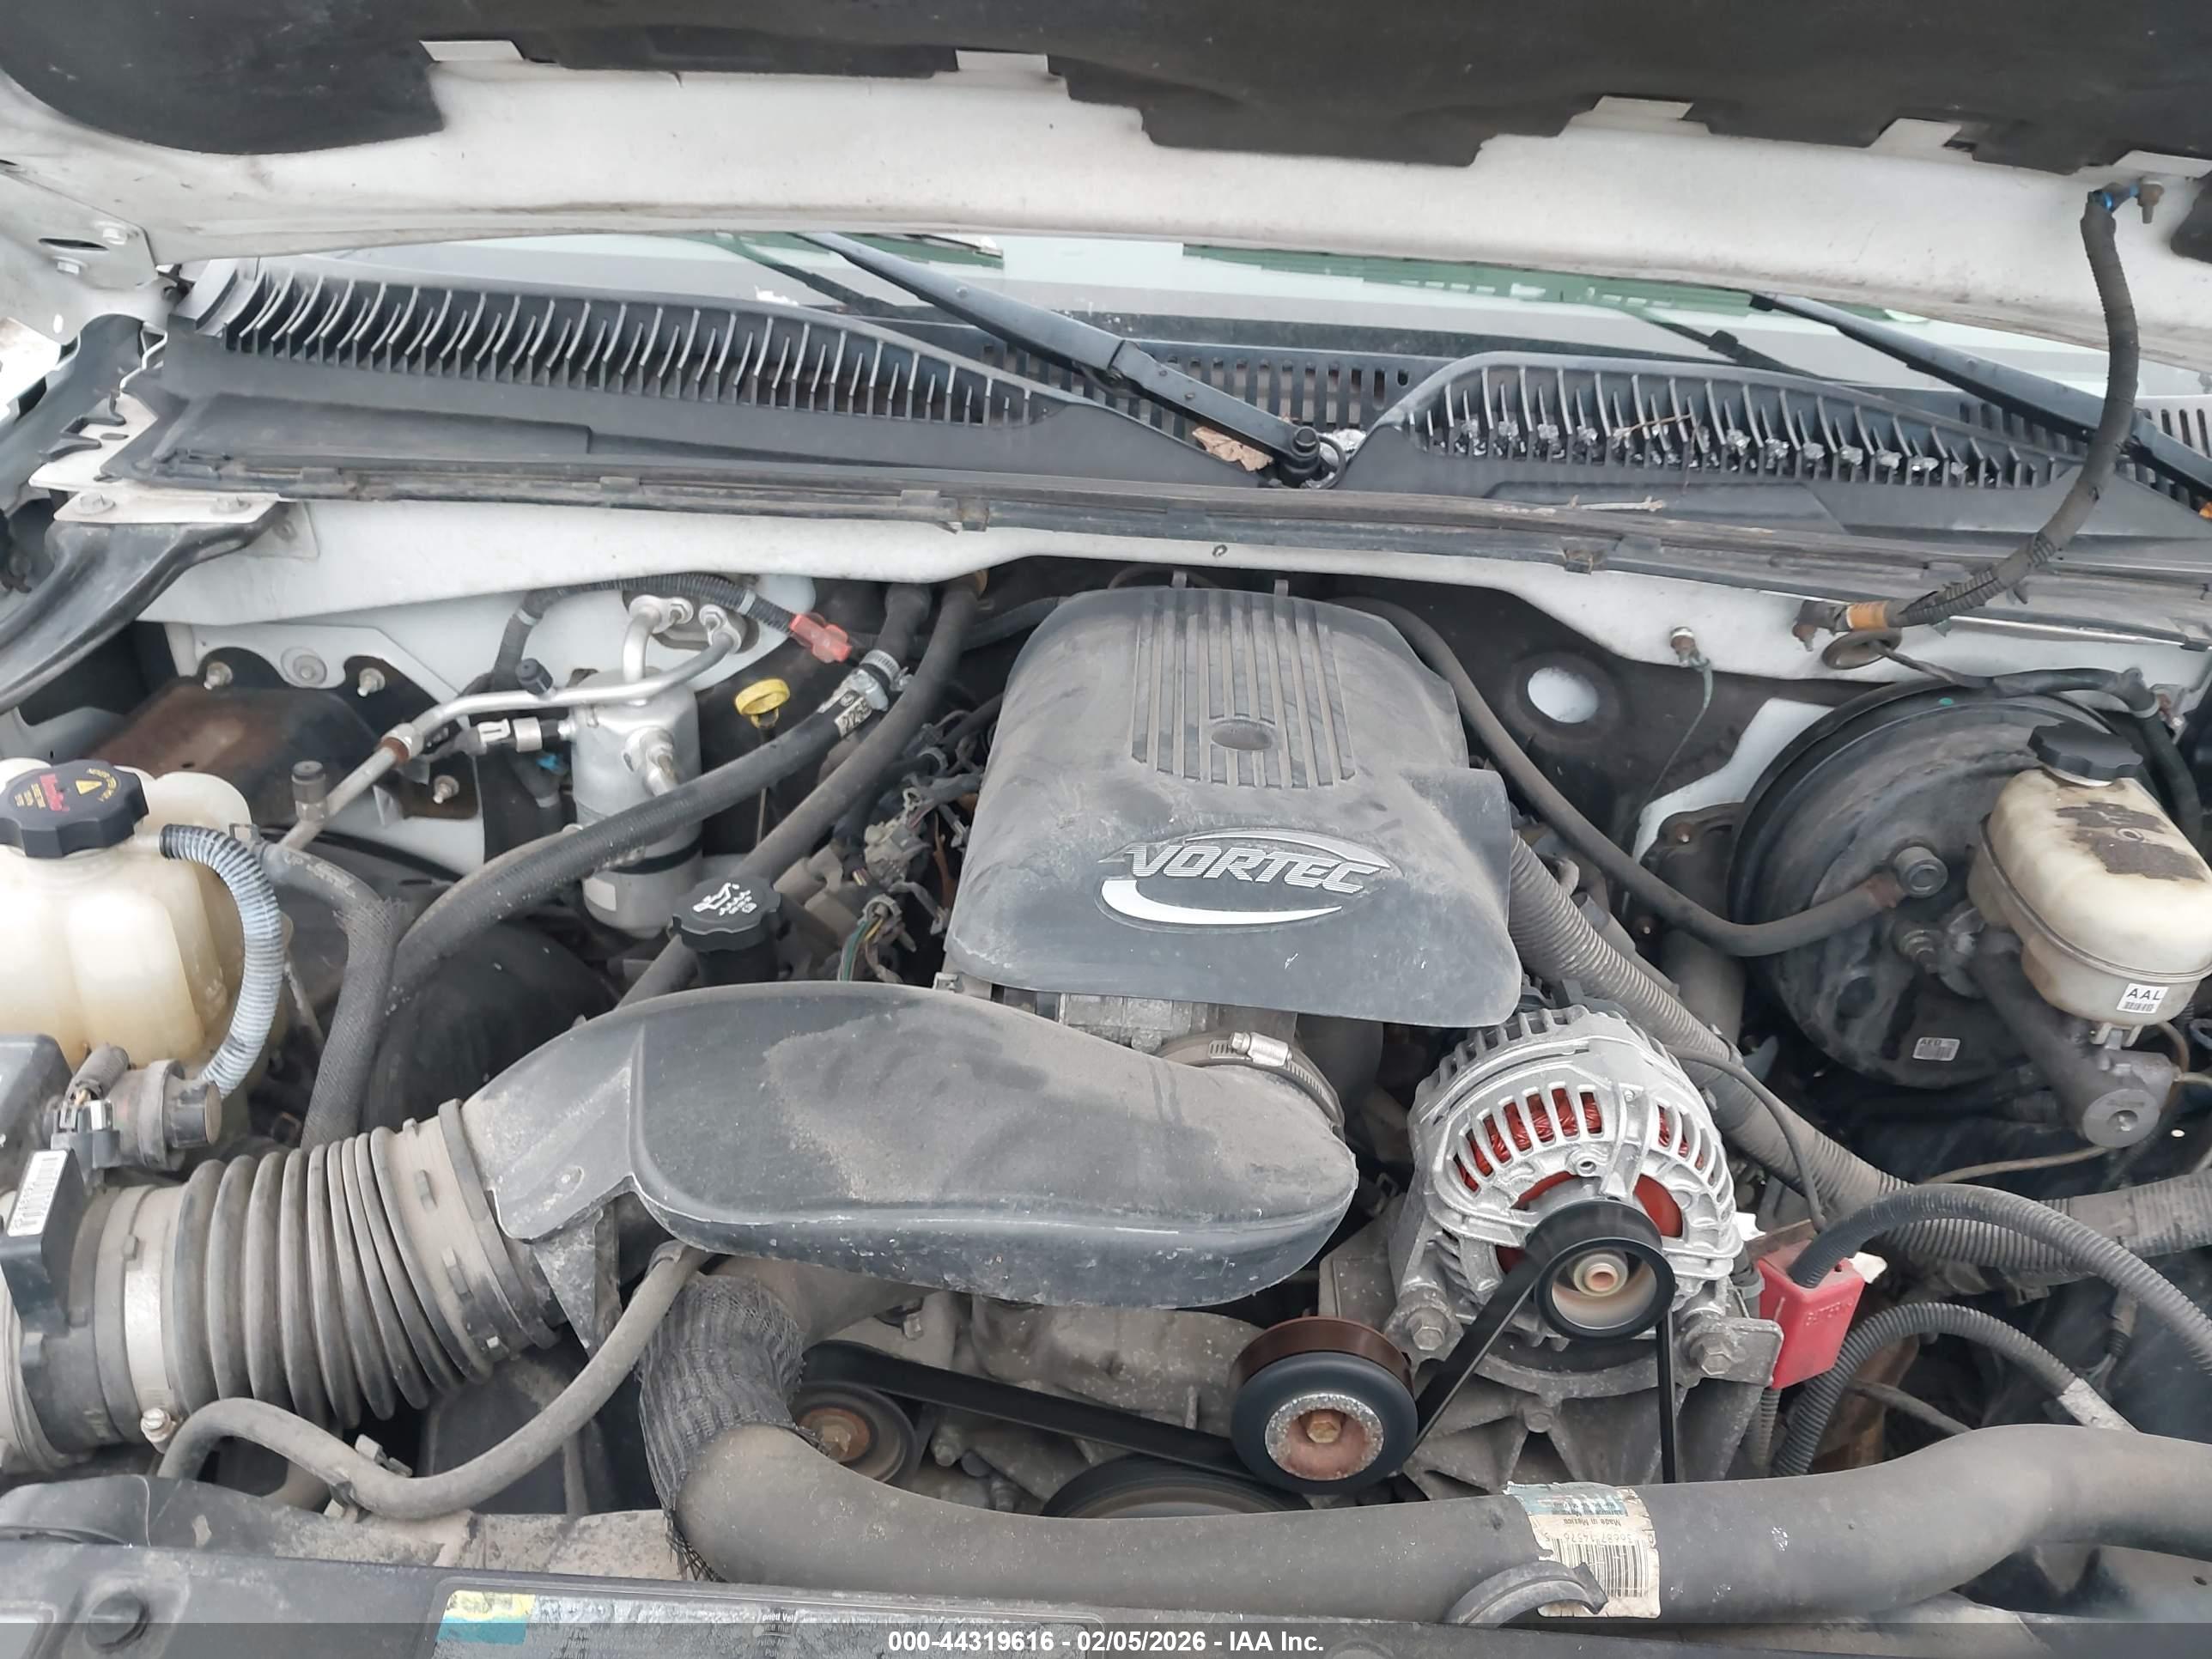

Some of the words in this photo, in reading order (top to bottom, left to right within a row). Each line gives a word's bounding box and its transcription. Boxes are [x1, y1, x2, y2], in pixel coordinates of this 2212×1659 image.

[1124, 844, 1381, 894] VORTEC
[2126, 988, 2160, 1001] AAL
[1601, 1517, 1621, 1527] Made
